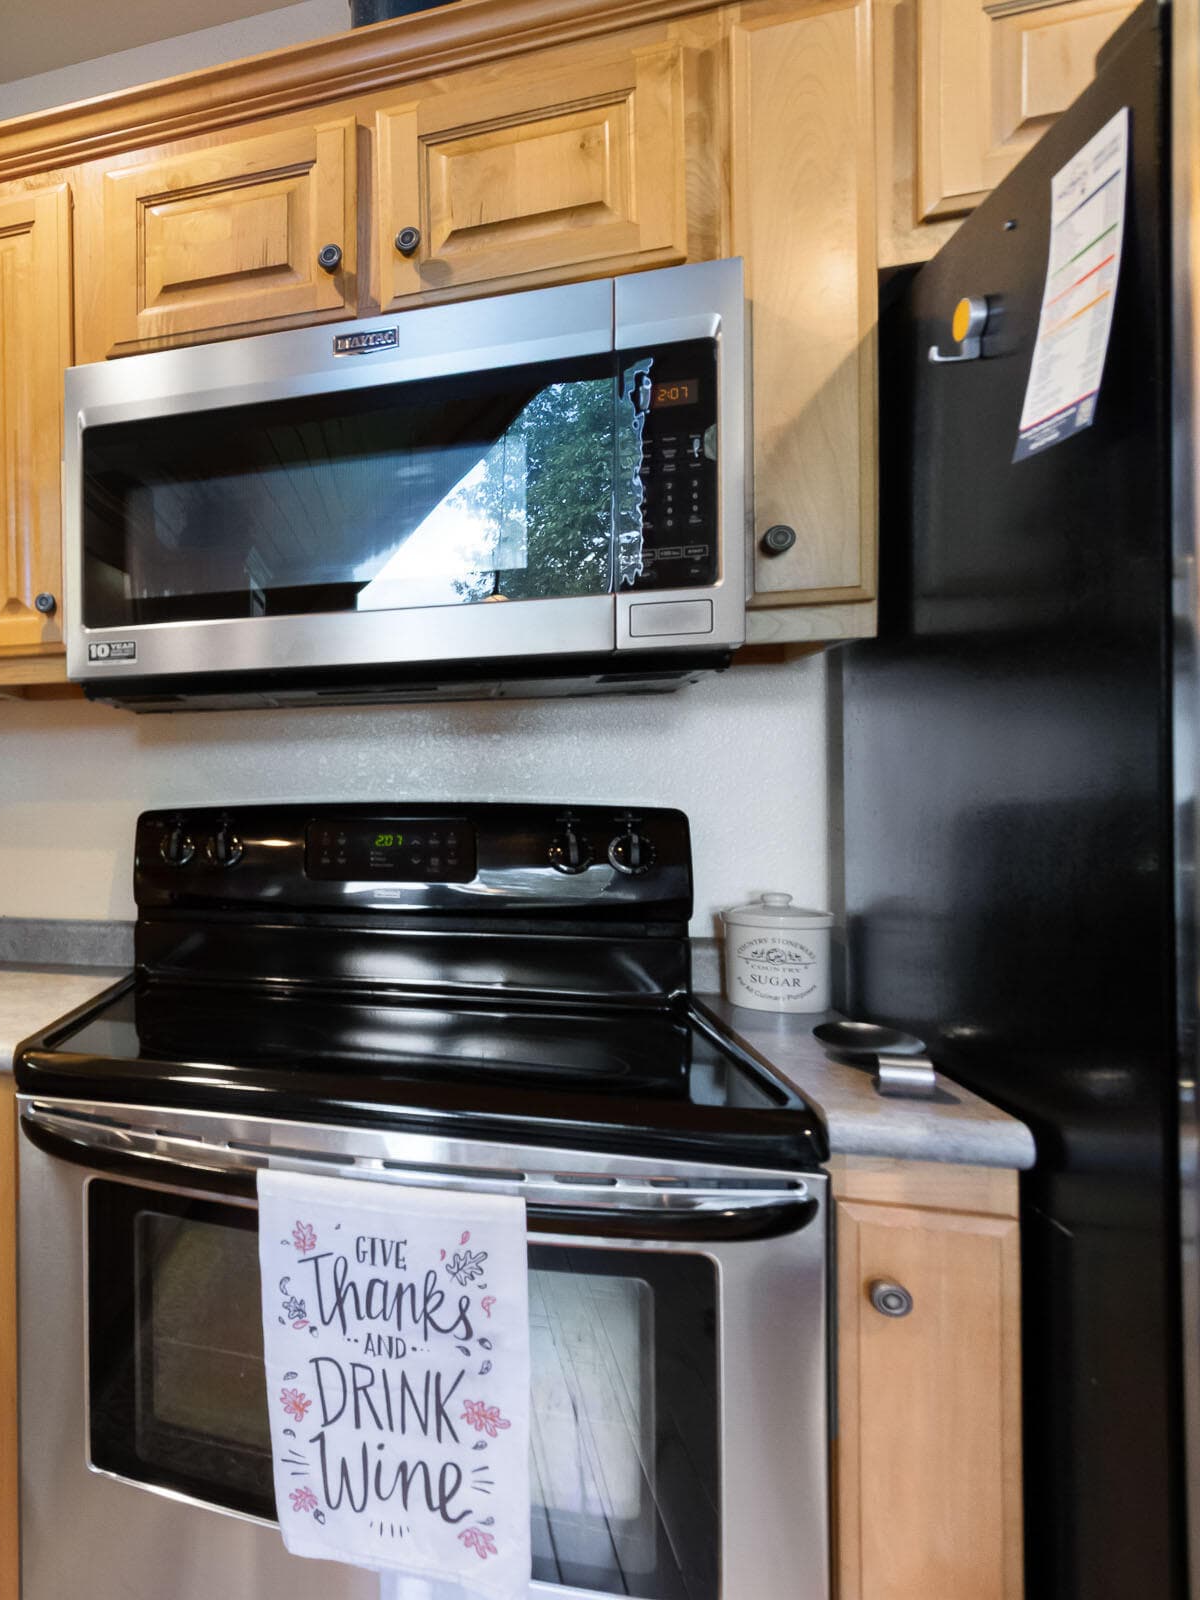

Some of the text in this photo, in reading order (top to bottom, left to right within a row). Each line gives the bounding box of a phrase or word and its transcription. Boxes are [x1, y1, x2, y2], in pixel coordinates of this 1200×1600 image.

[337, 330, 395, 350] MAYTAG
[657, 385, 689, 402] 2:07
[90, 644, 110, 658] 10
[749, 974, 802, 988] SUGAR
[355, 1235, 408, 1272] GIVE
[297, 1252, 474, 1343] Thanks
[363, 1332, 407, 1360] AND
[309, 1356, 466, 1444] DRINK
[308, 1430, 473, 1525] Wine
